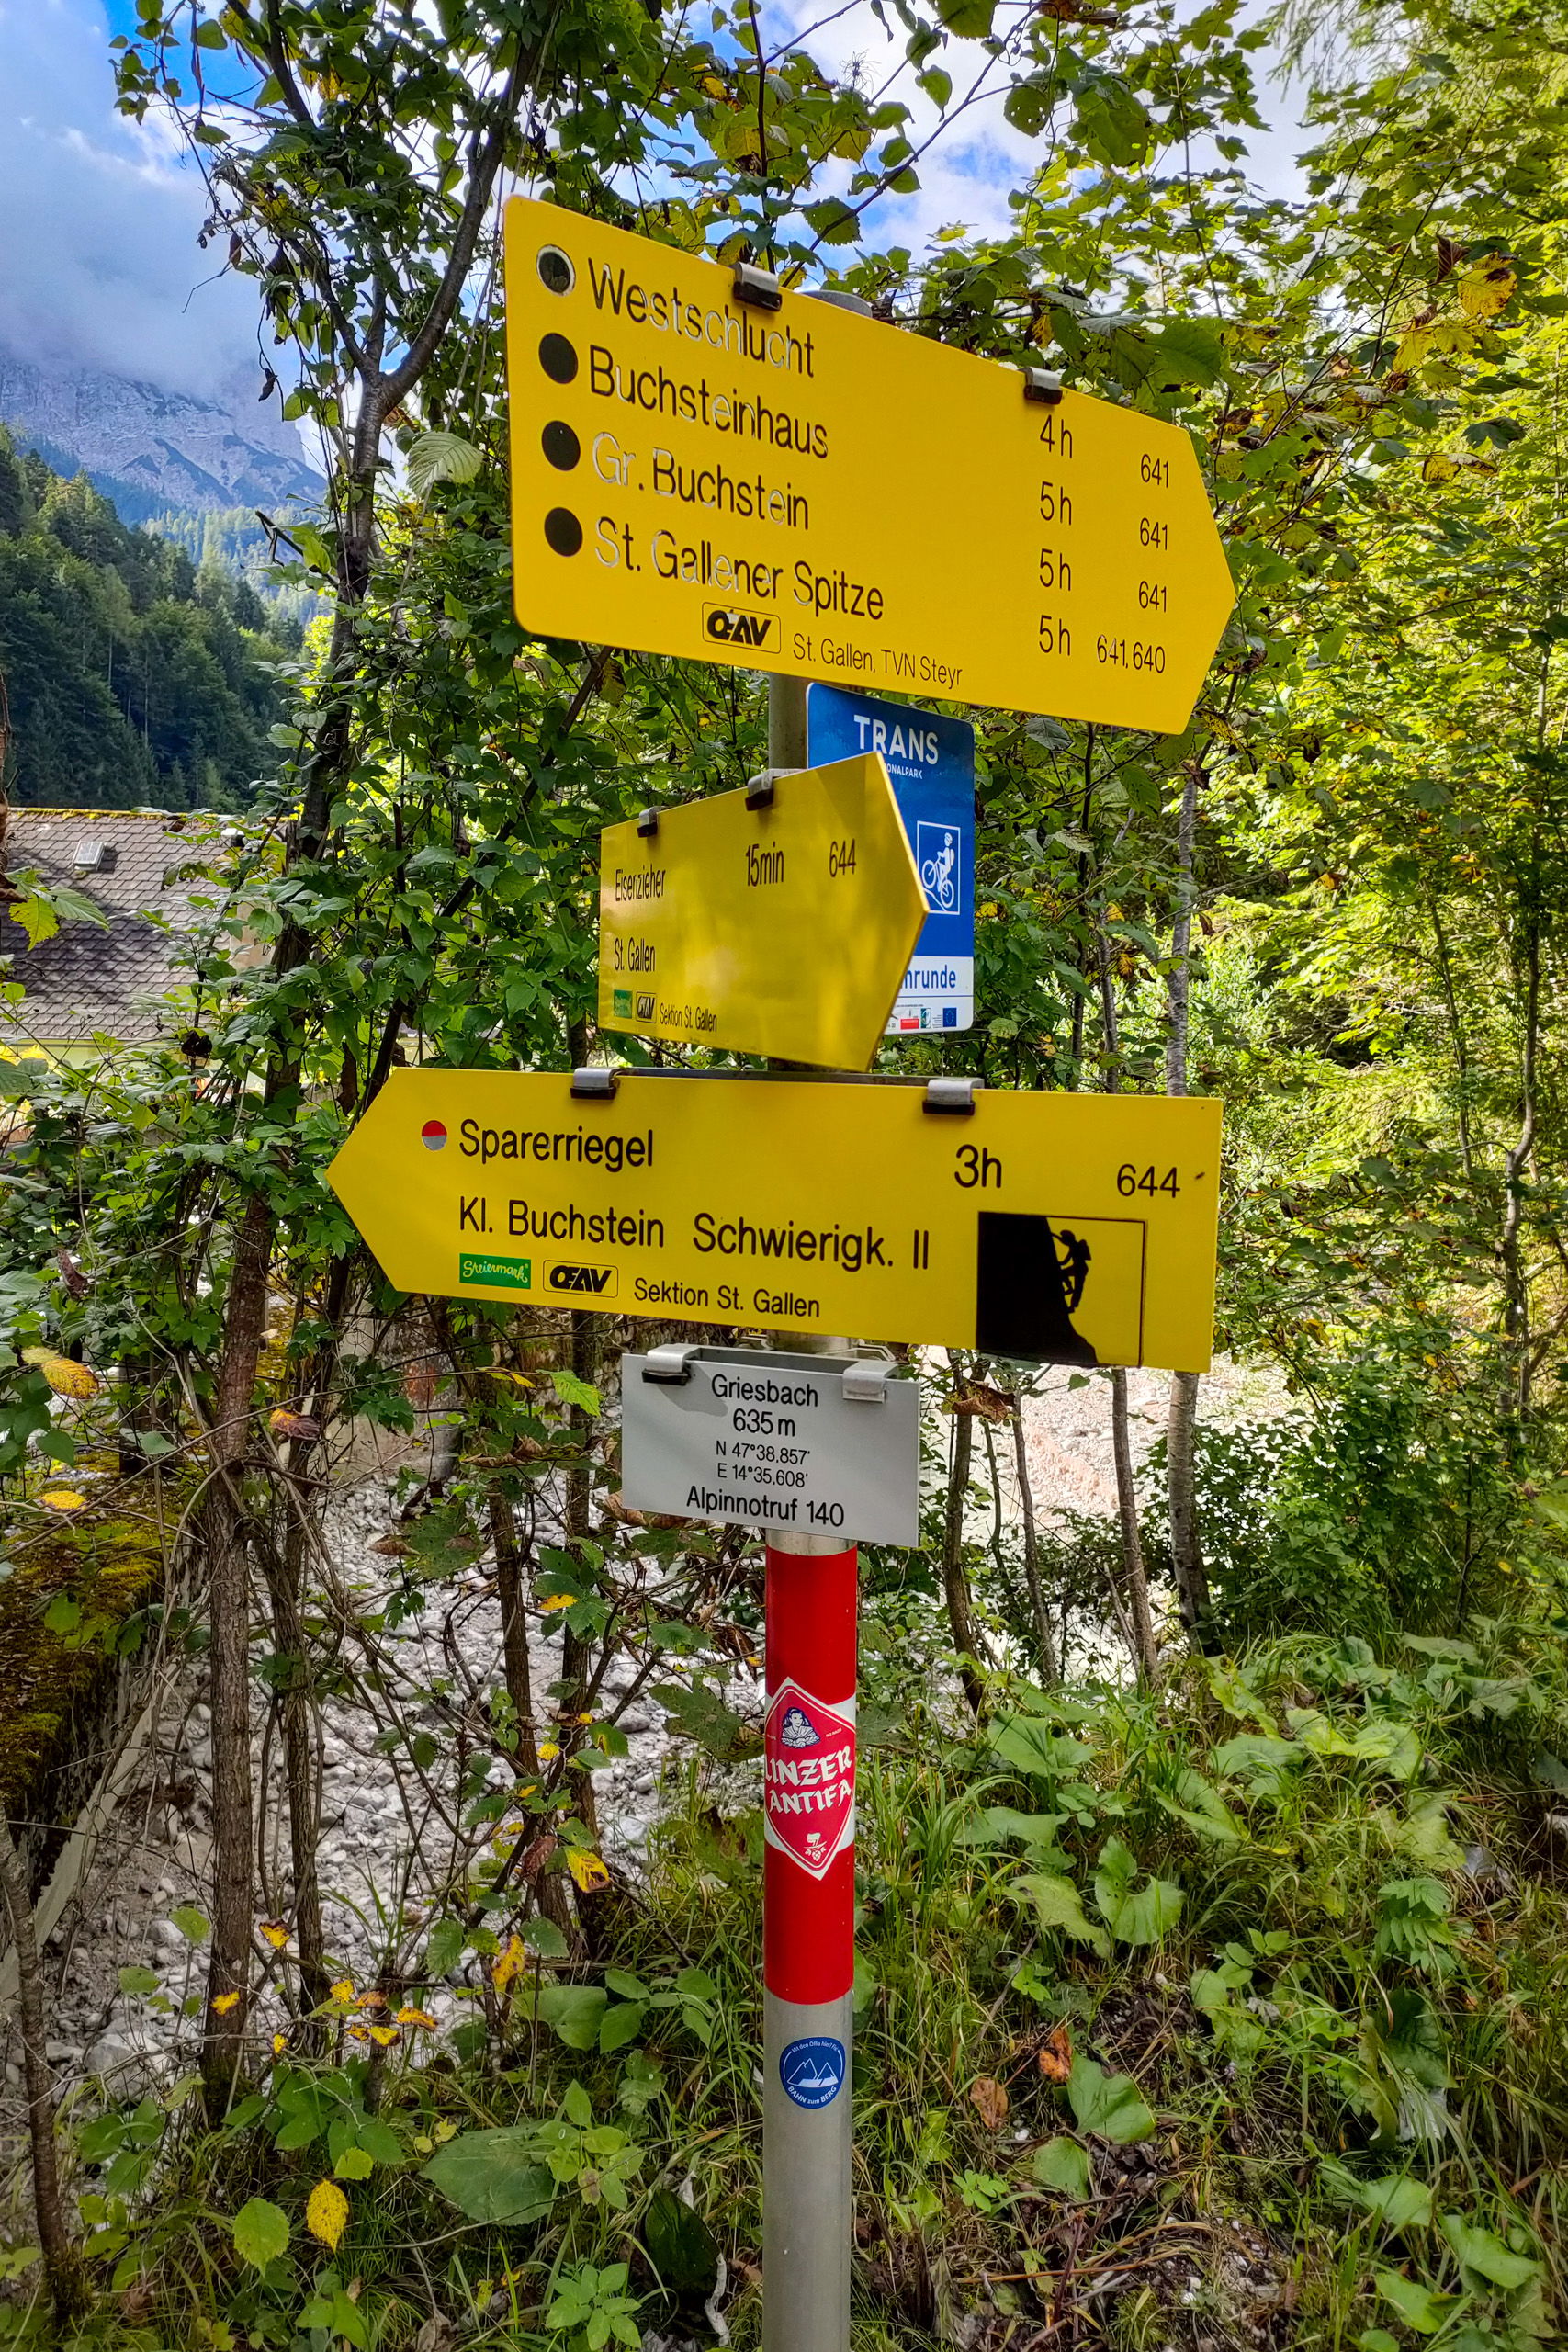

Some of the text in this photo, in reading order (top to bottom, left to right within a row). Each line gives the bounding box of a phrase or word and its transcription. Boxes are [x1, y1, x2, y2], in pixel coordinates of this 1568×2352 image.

[587, 257, 815, 378] Westschlucht
[589, 345, 829, 458] Buchsteinhaus
[592, 431, 809, 530] Gr. Buchstein
[1141, 454, 1169, 488] 641
[1139, 517, 1168, 550] 641
[594, 516, 884, 620] St. Gallener Spitze
[1138, 581, 1167, 613] 641
[793, 633, 816, 662] St.
[880, 649, 916, 678] TVN
[919, 656, 963, 689] Steyr
[853, 714, 939, 764] TRANS
[885, 763, 923, 779] ONALPARK
[829, 839, 856, 878] 644
[615, 863, 666, 901] Eisenzieher
[614, 937, 656, 972] St. Gallen
[901, 964, 956, 989] nrunde
[660, 1002, 682, 1027] Sektion
[684, 1005, 693, 1028] St.
[695, 1006, 717, 1032] Gallen
[459, 1118, 653, 1173] Sparerriegel
[954, 1144, 1002, 1189] 3h
[1116, 1163, 1180, 1199] 644
[459, 1195, 493, 1234] Kl.
[508, 1199, 664, 1248] Buchstein
[693, 1212, 894, 1272] Schwierigk.
[634, 1278, 820, 1318] Sektion St. Gallen
[711, 1374, 818, 1407] Griesbach
[716, 1441, 727, 1456] N
[717, 1463, 728, 1478] E
[686, 1486, 844, 1527] Alpinnotruf 140
[765, 1746, 852, 1786] LINZER
[769, 1779, 852, 1815] ANTIFA
[788, 2086, 807, 2104] BAHN
[820, 2086, 837, 2103] BERG
